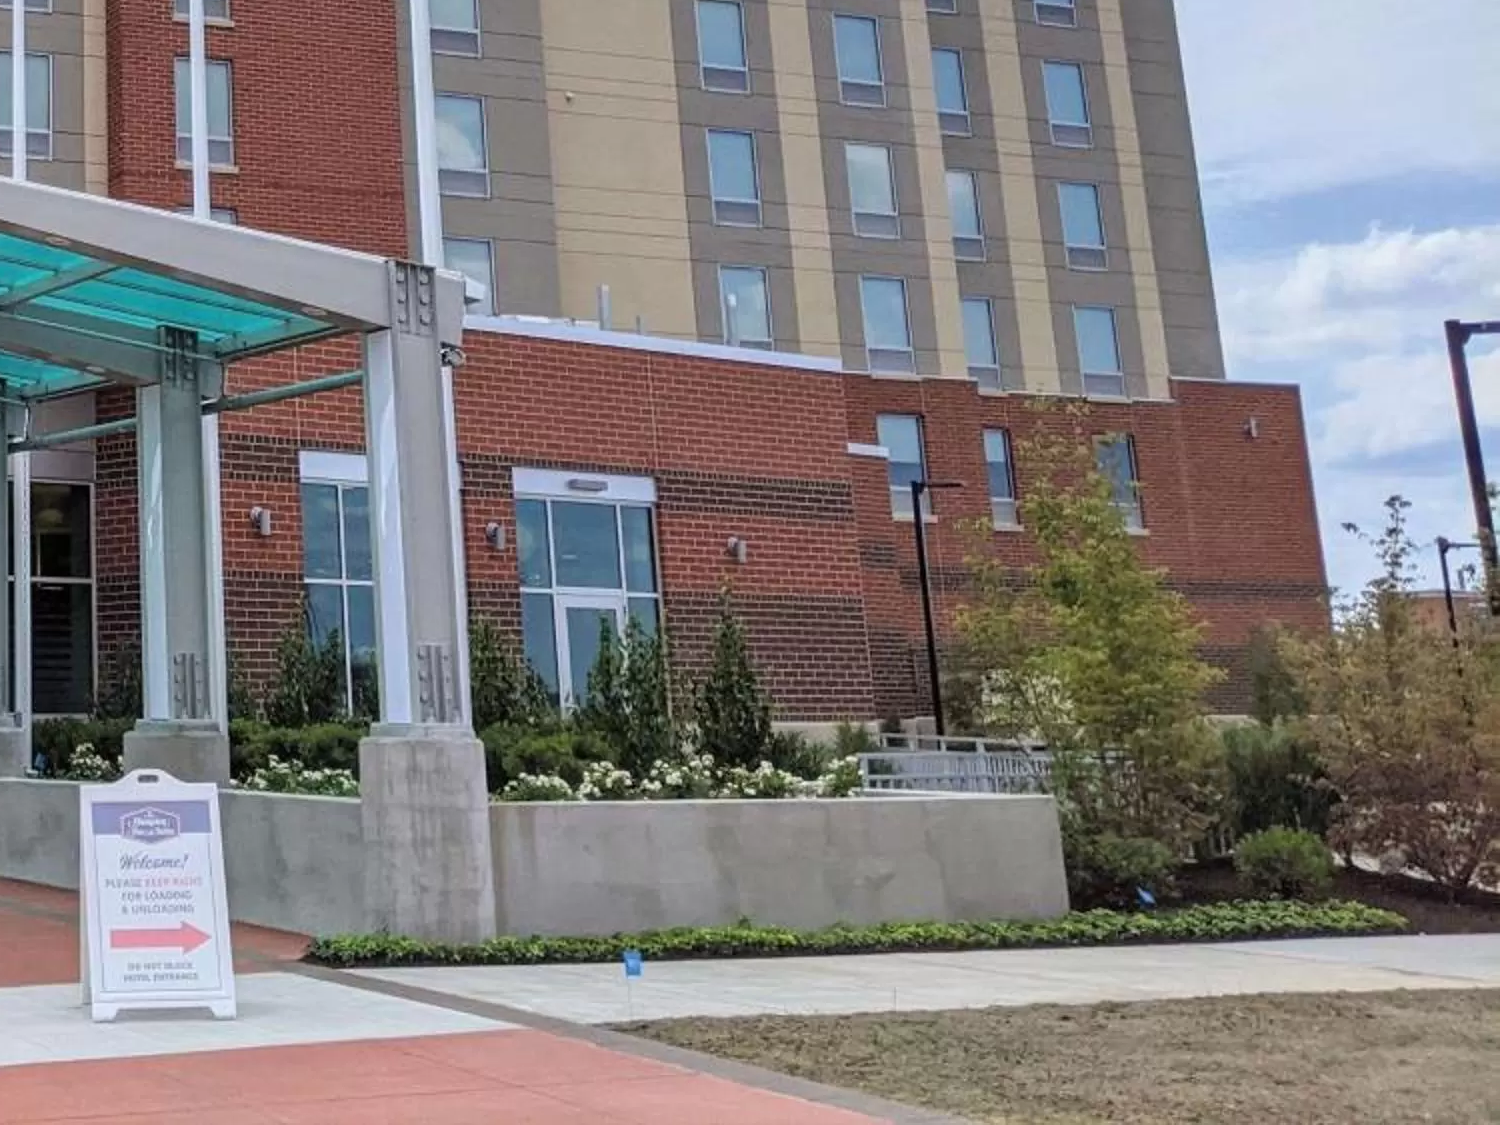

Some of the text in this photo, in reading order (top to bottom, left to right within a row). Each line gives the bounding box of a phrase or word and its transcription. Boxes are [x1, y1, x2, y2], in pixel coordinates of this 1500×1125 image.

[120, 852, 189, 870] Welcome!
[105, 878, 142, 888] PLEASE
[122, 889, 193, 901] FOR LOADING
[131, 904, 195, 915] UNLOADING
